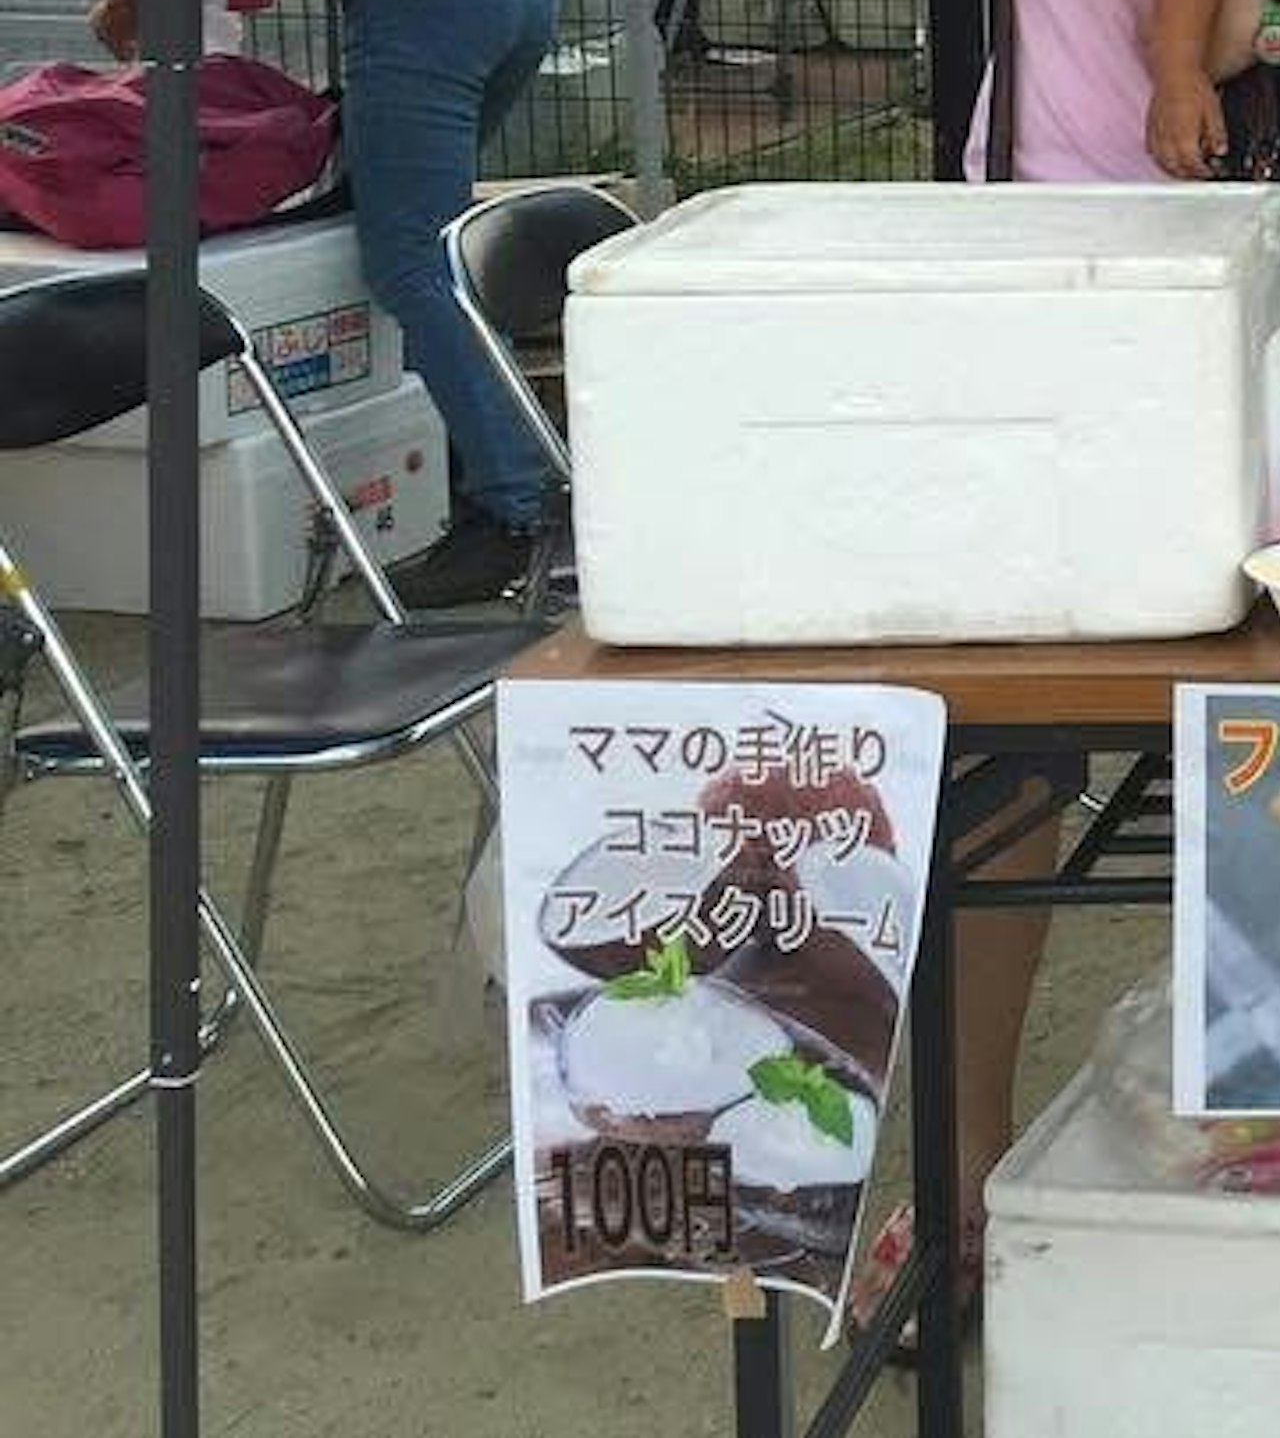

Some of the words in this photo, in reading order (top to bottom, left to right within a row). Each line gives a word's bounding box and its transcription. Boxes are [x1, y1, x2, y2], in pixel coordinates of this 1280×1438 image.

[568, 712, 887, 788] ママの手作り
[602, 802, 875, 866] ココナッツ
[548, 882, 905, 950] アイスクリーム
[549, 1142, 734, 1254] 100円
